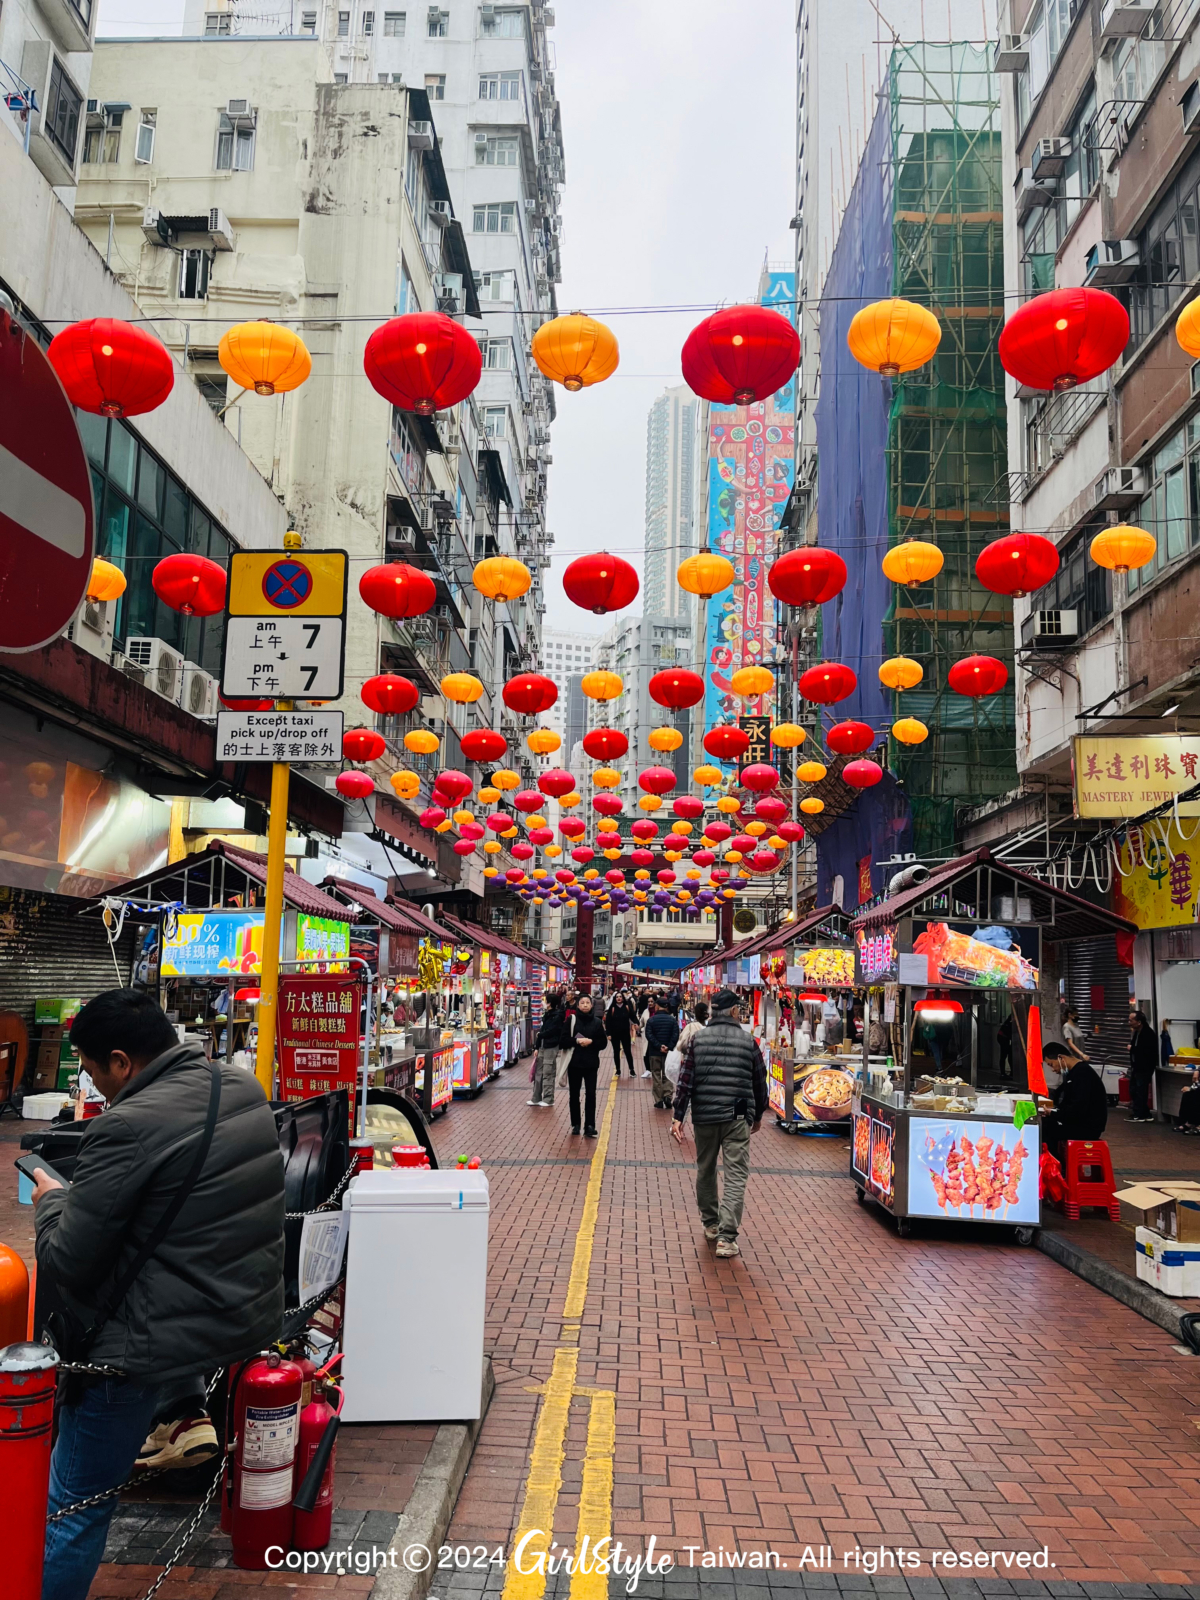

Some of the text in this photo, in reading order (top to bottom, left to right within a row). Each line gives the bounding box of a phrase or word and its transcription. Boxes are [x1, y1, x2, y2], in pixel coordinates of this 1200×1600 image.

[256, 622, 276, 631] am
[249, 635, 282, 649] 上午
[302, 624, 321, 649] 7
[253, 664, 274, 675] pm
[247, 677, 279, 691] 下午
[300, 666, 318, 691] 7
[247, 715, 313, 726] Except taxi
[230, 728, 328, 740] pick up/drop off
[223, 742, 335, 757] 的士上落客除外
[1082, 752, 1199, 781] 美達利珠寶
[1082, 791, 1134, 803] MASTERY
[284, 991, 353, 1014] 方太糕品舖
[283, 1038, 356, 1050] Traditional Chinese Desserts
